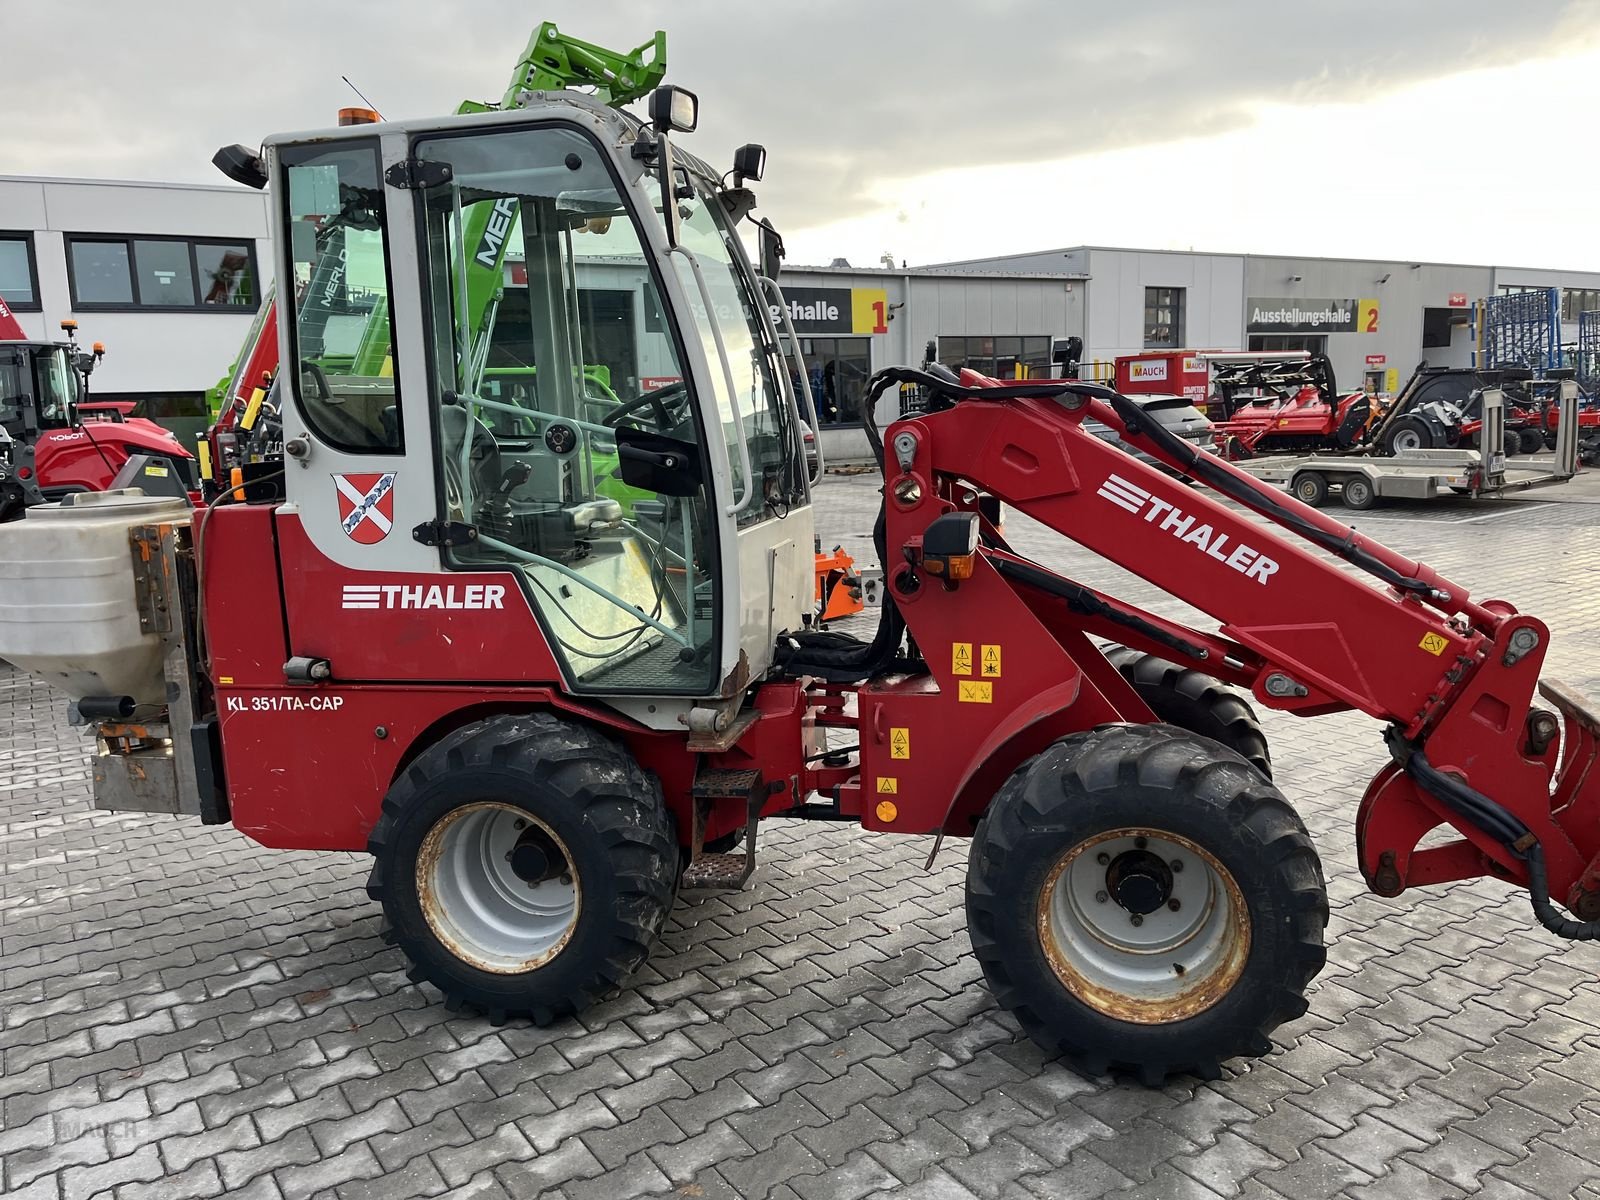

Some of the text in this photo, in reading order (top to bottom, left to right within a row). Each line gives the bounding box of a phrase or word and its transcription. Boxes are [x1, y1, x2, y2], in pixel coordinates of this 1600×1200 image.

[872, 301, 888, 334] 1
[1252, 307, 1379, 333] Ausstellungshalle 2
[1134, 366, 1165, 377] MAUCH
[1185, 361, 1206, 370] MAUCH
[1144, 495, 1280, 585] THALER
[382, 585, 506, 609] THALER
[226, 696, 344, 711] KL 351/TA-CAP
